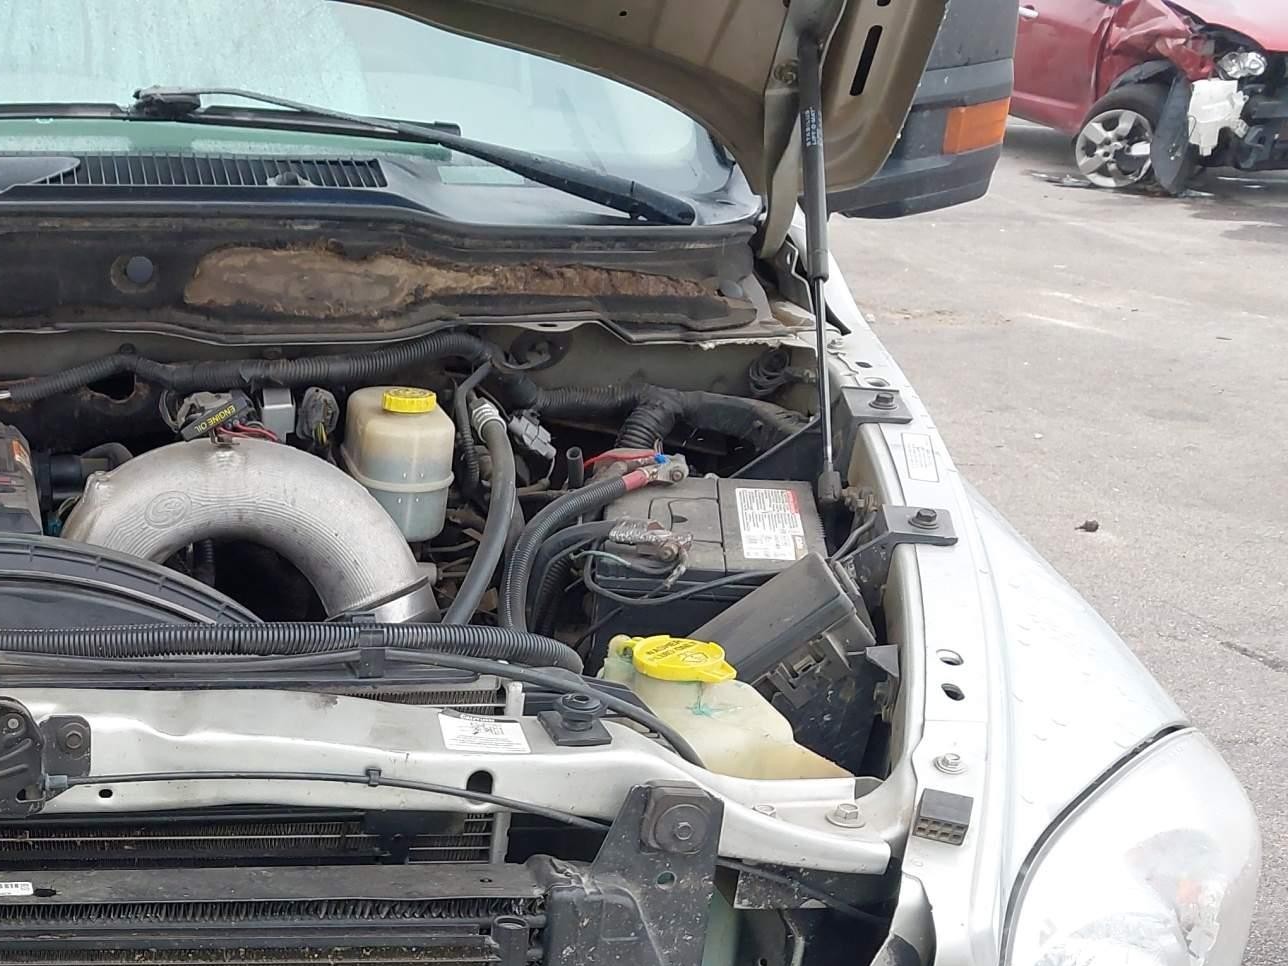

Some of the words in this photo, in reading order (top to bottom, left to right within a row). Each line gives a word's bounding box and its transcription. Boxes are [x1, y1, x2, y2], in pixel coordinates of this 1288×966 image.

[206, 405, 236, 425] ENGINE
[194, 421, 208, 432] OIL
[645, 640, 681, 655] WASHER
